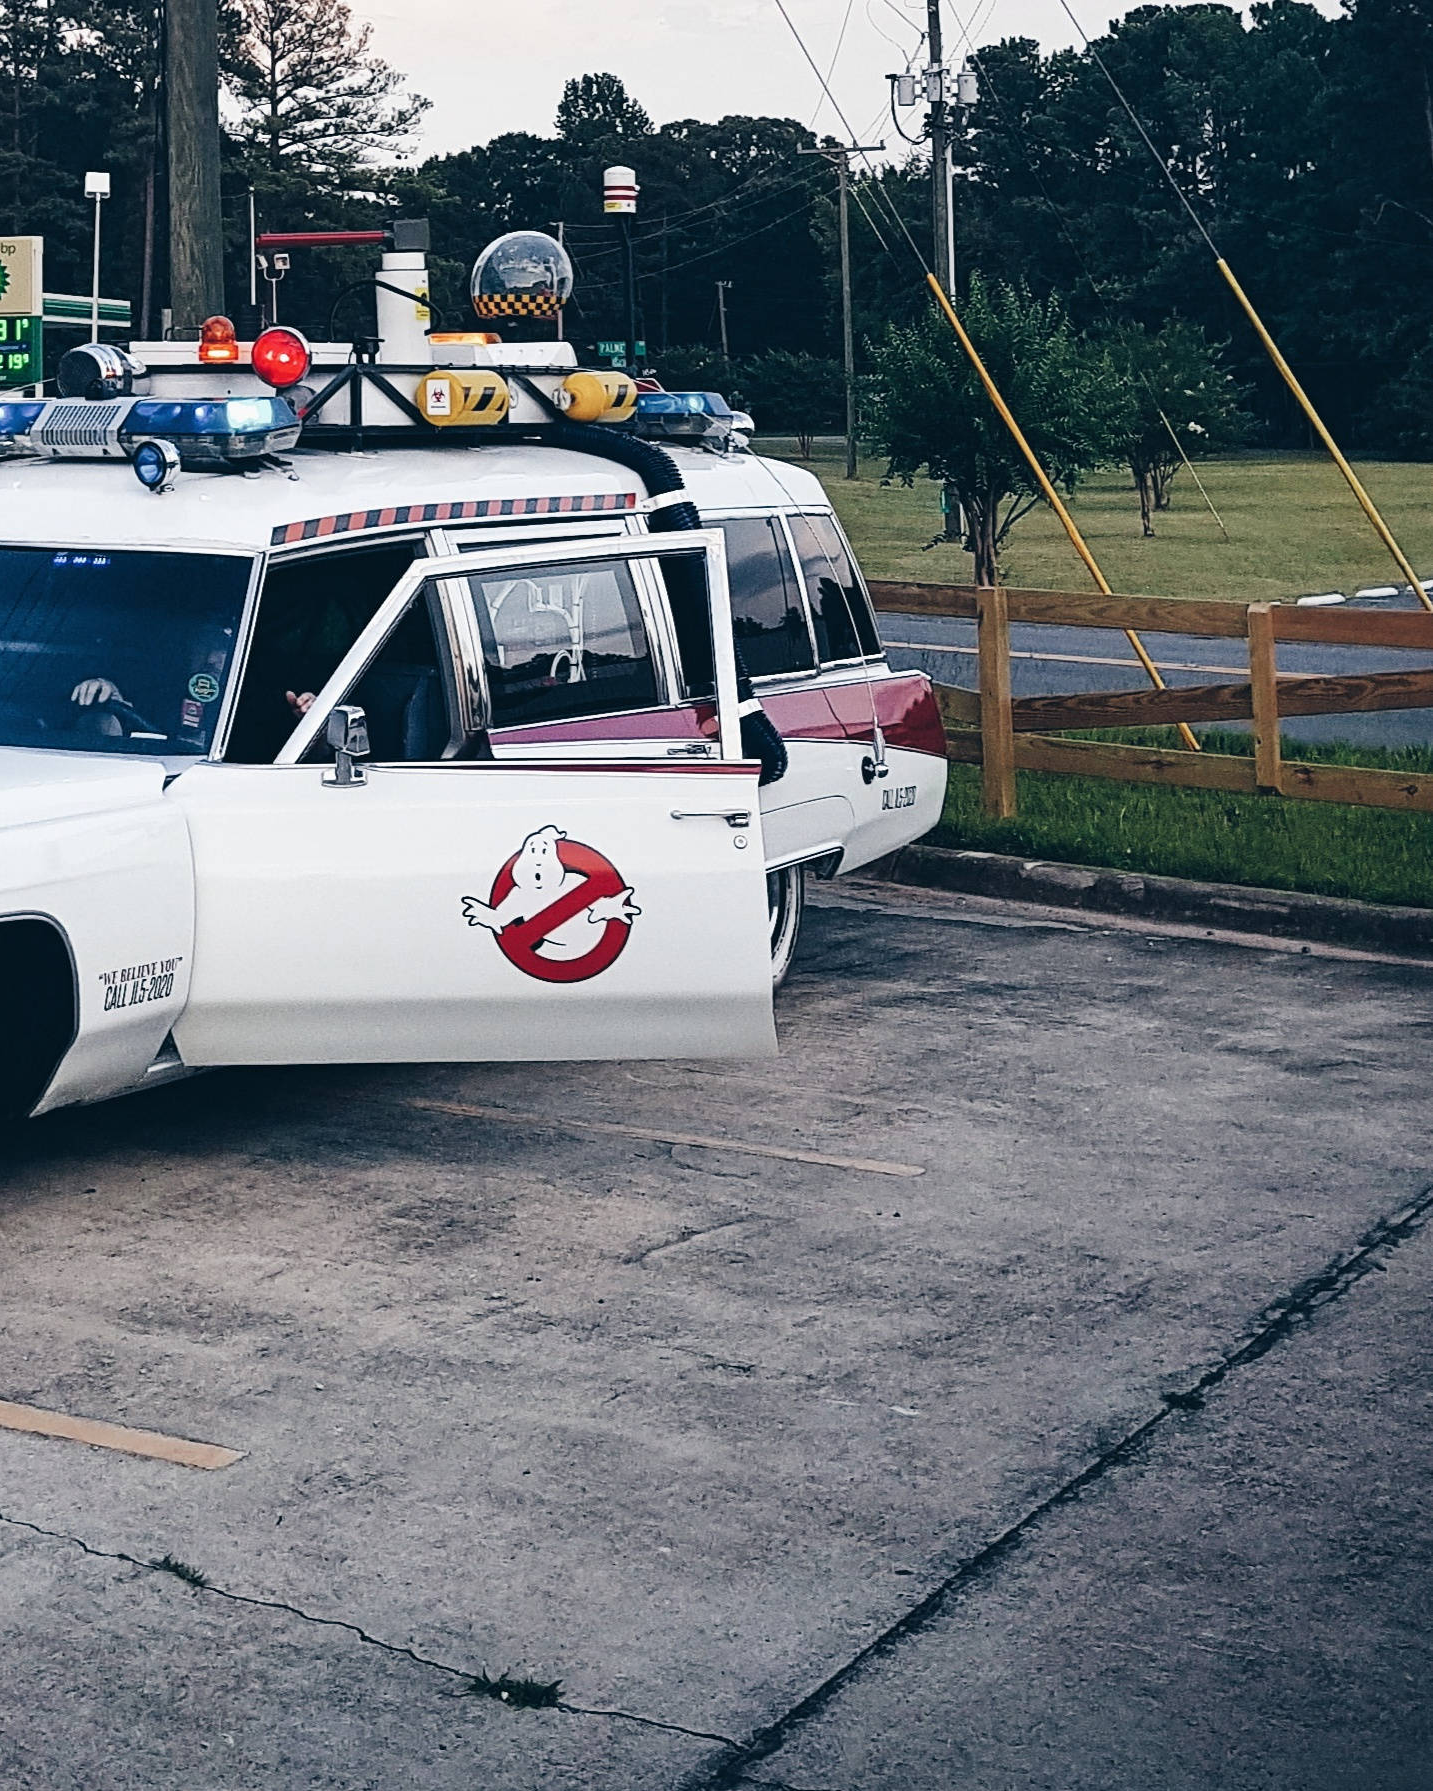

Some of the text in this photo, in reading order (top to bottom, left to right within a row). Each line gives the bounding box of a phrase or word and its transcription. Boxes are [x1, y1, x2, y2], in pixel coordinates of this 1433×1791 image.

[0, 242, 16, 256] bp
[599, 343, 626, 354] PALME
[120, 961, 158, 983] BELIEVE
[103, 982, 127, 1012] CALL
